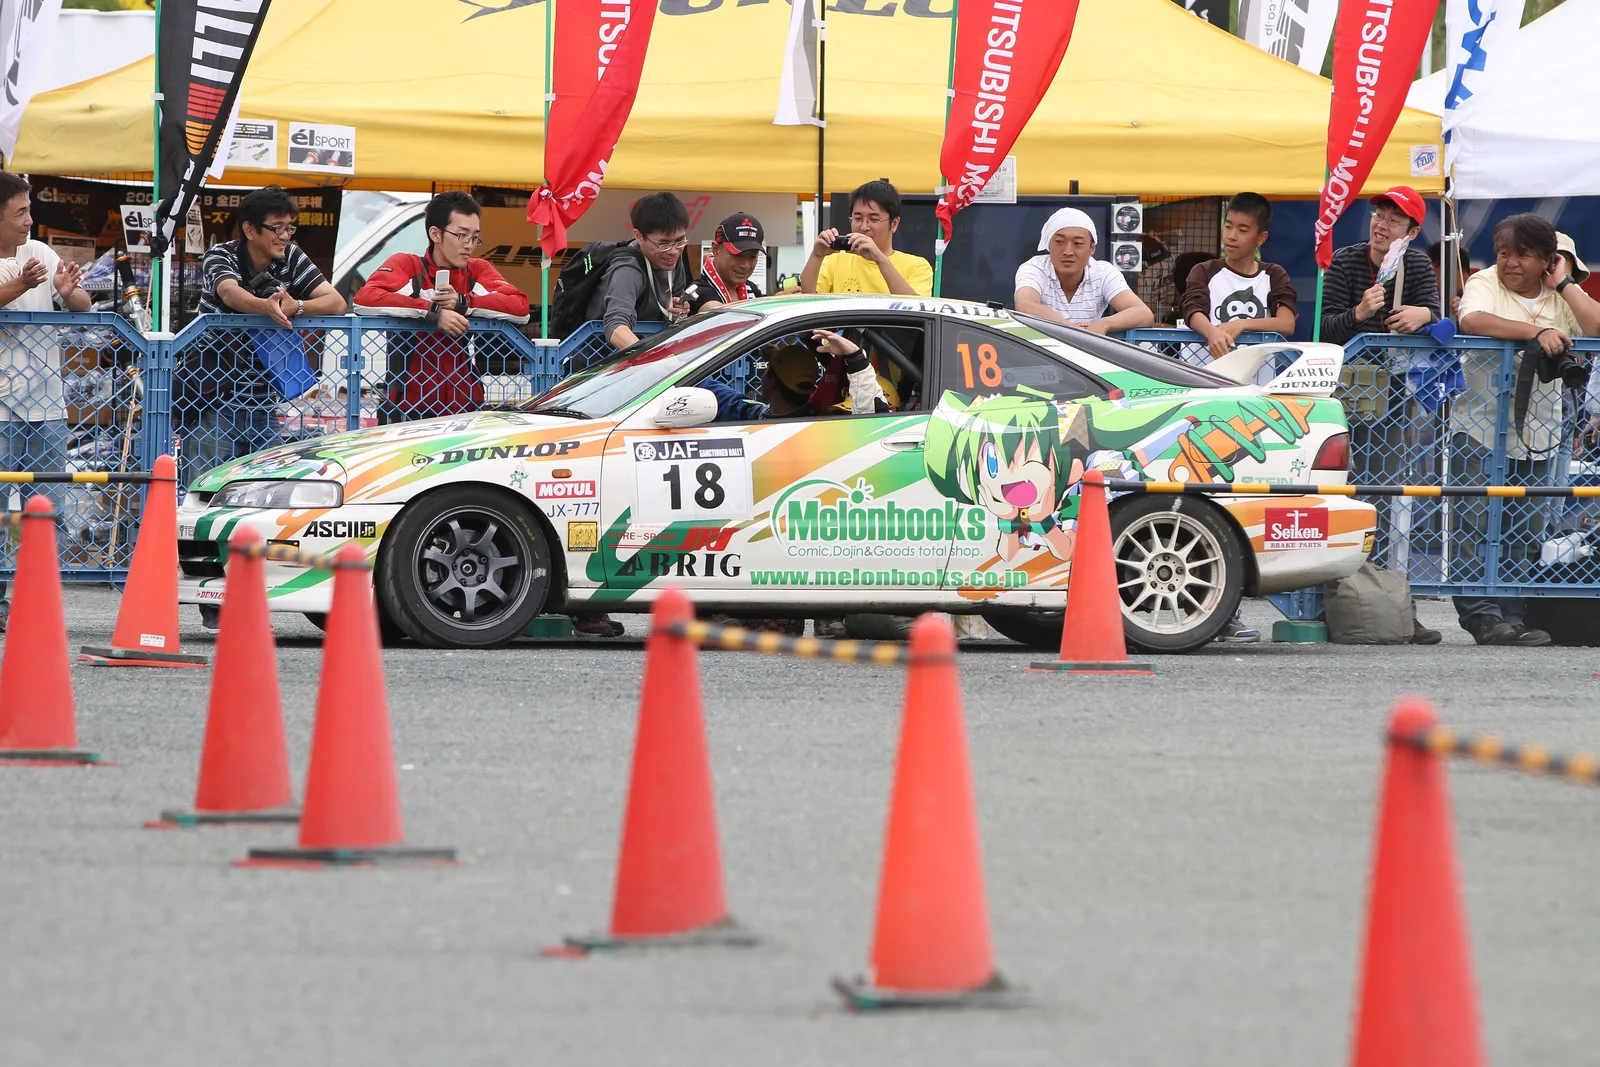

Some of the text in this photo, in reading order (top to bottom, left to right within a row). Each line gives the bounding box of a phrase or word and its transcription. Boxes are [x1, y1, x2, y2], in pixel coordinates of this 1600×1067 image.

[972, 0, 1024, 154] ITSUBISHI
[956, 343, 1003, 389] 18
[1280, 380, 1338, 389] DUNLOP
[440, 441, 580, 464] DUNLOP
[658, 441, 699, 460] JAF
[538, 482, 594, 497] MOTUL
[663, 462, 726, 510] 18
[547, 502, 600, 518] JX-777
[787, 500, 986, 541] Melonbooks
[1270, 509, 1323, 540] Seiken
[918, 545, 948, 557] total
[950, 544, 984, 559] shop.
[750, 568, 1028, 588] www.melonbooks.co.jp
